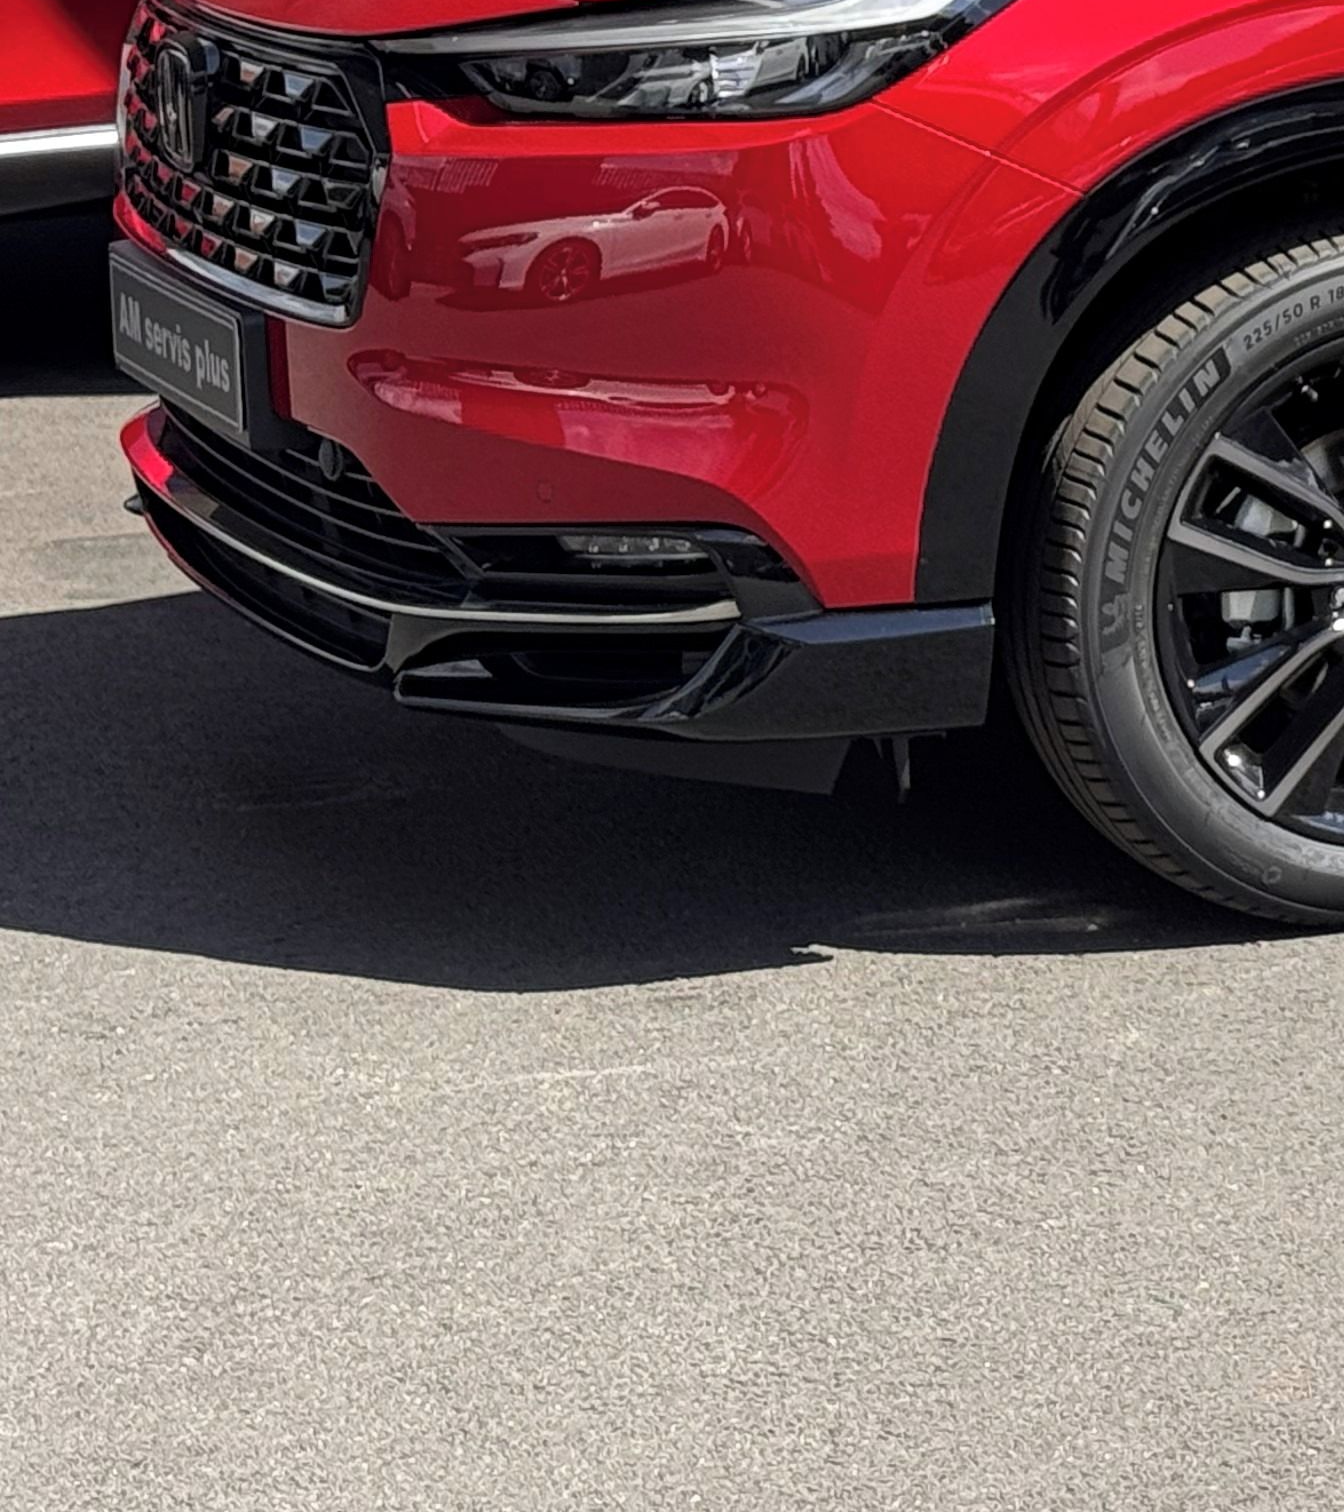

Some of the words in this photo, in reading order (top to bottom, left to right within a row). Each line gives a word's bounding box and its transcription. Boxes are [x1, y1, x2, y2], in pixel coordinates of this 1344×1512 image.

[119, 291, 142, 344] AM
[145, 317, 192, 373] servis
[195, 339, 231, 393] plus
[1243, 303, 1305, 351] 225/50
[1309, 294, 1322, 311] R
[1104, 359, 1221, 584] MICHELIN
